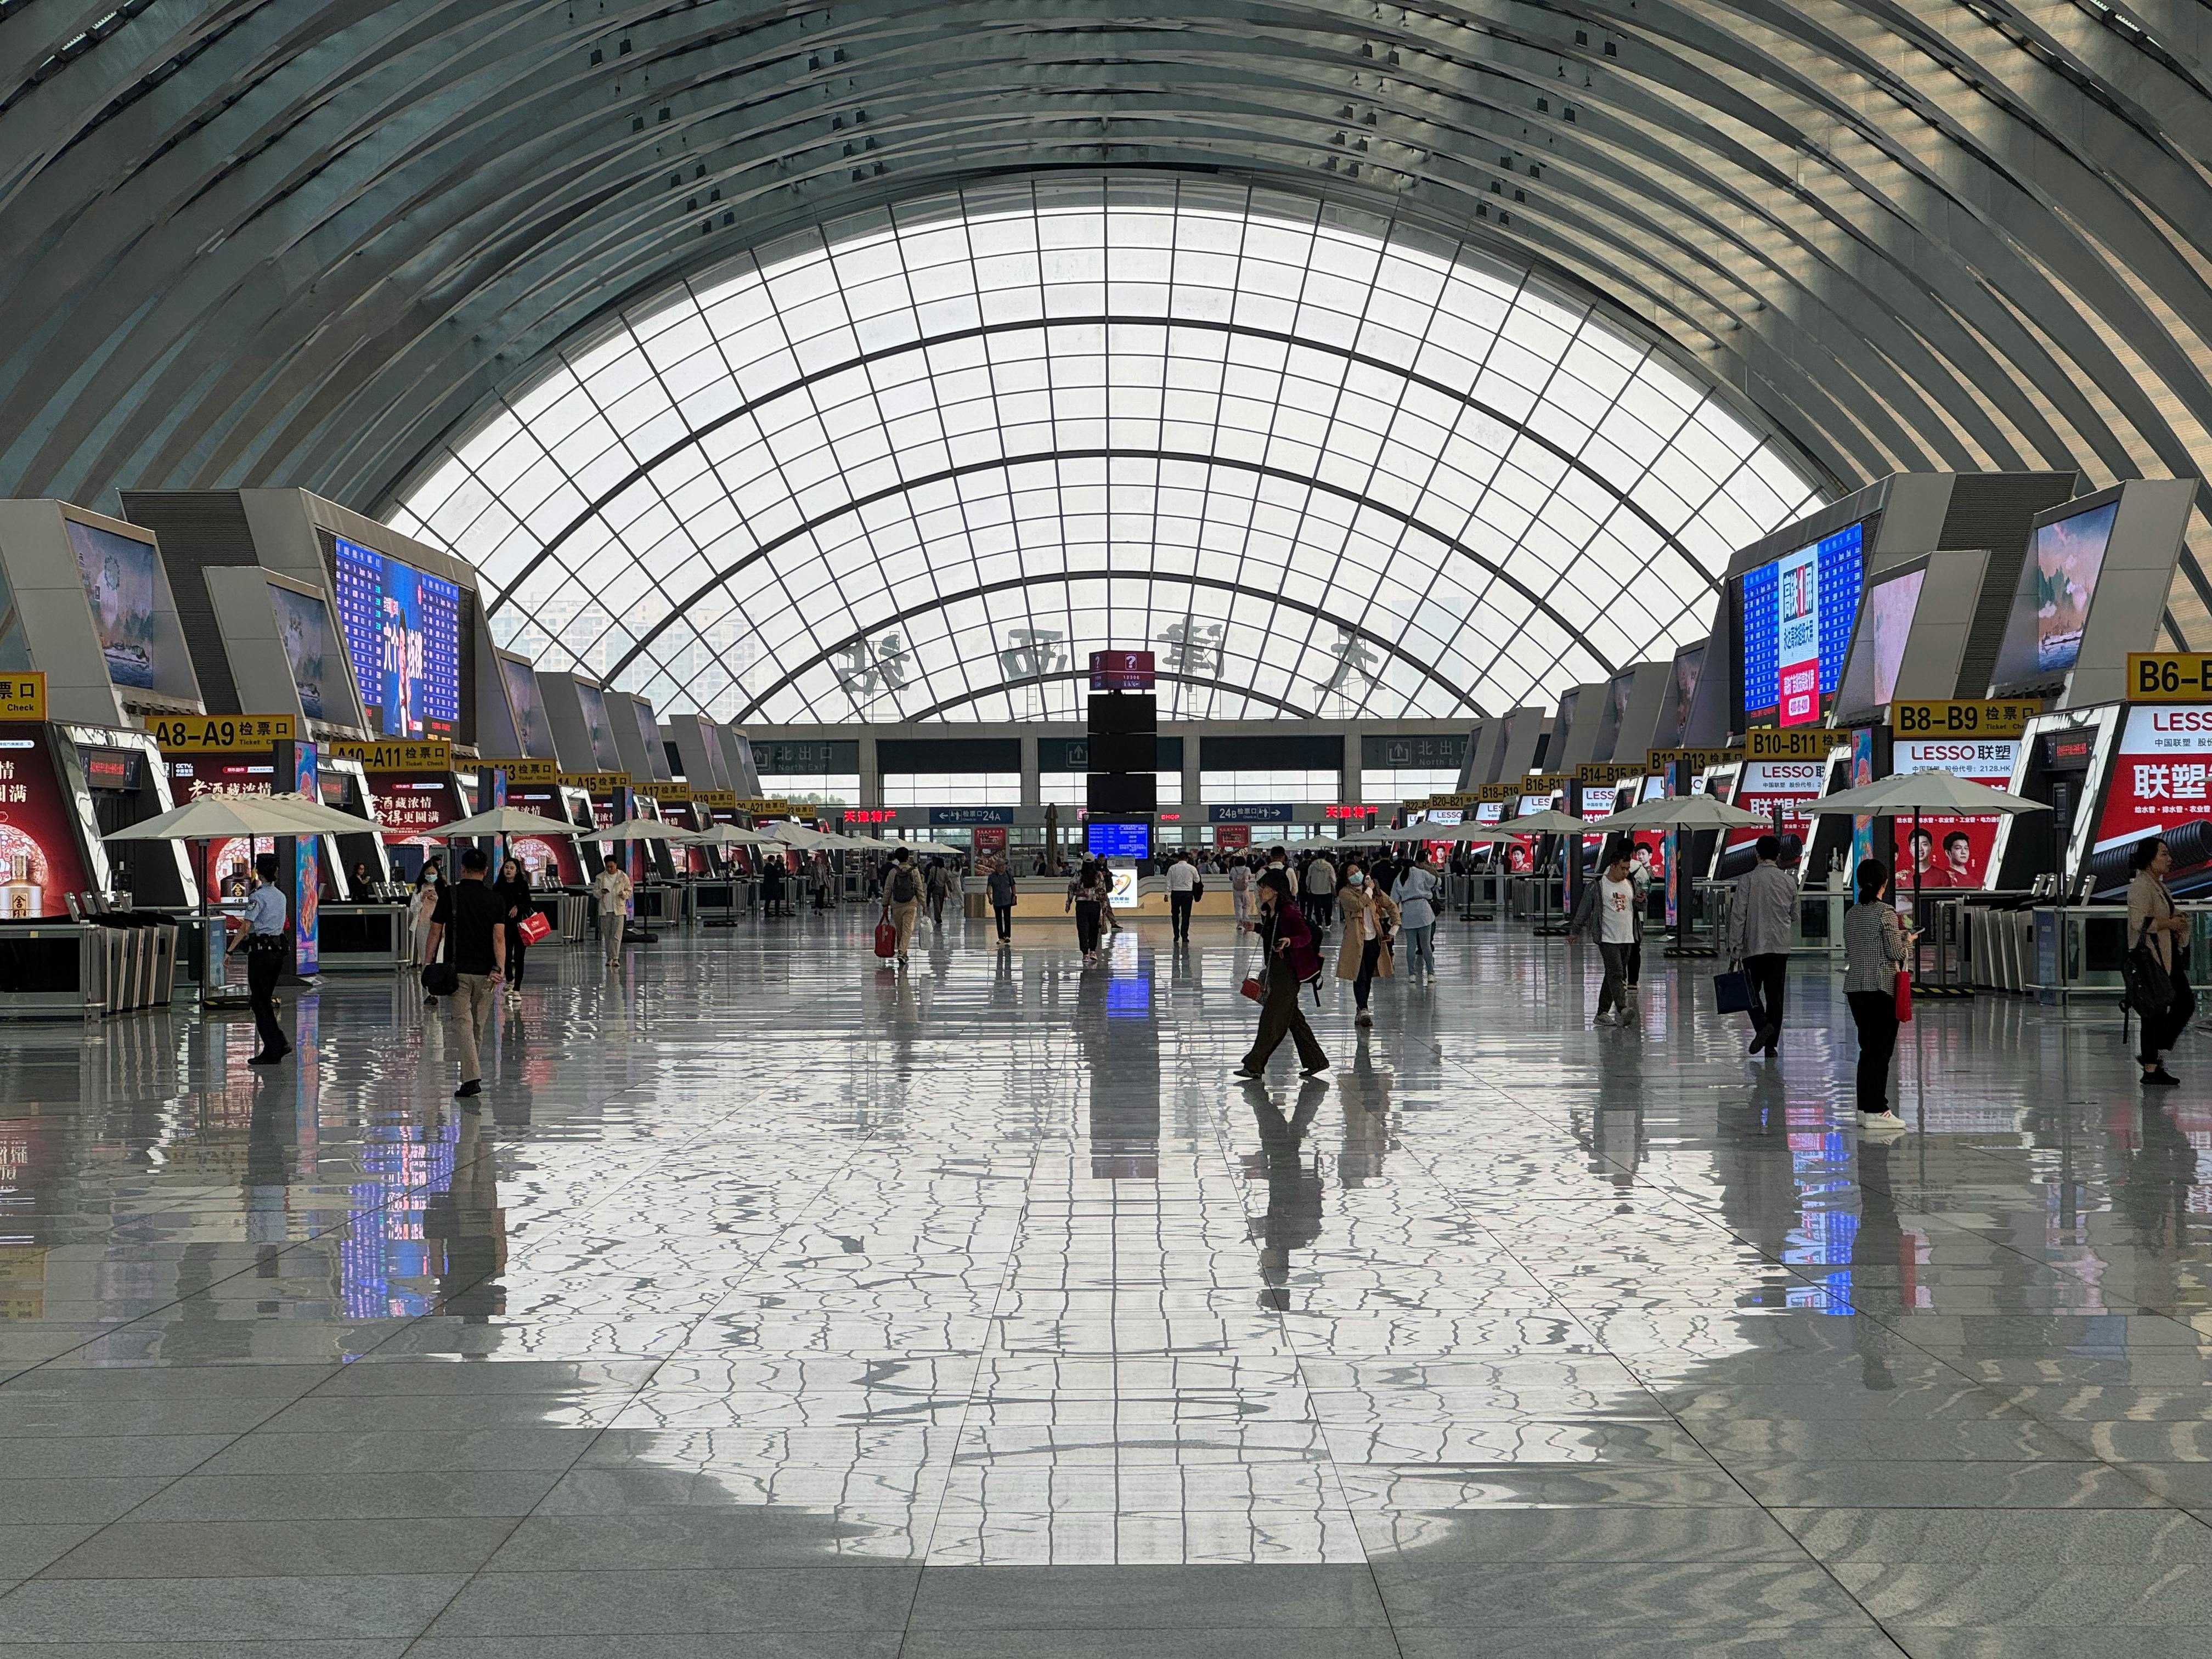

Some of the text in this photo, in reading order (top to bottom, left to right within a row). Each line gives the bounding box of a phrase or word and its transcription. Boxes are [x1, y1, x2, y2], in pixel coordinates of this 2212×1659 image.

[1900, 706, 2034, 731] B8-B9 检票口
[156, 721, 287, 746] A8-A9 检票口
[1754, 733, 1816, 754] B10-B11
[2154, 738, 2191, 747] 中国联塑
[405, 747, 444, 758] 检票口
[777, 746, 832, 760] 北出口
[1911, 745, 2011, 760] LESSO 联塑
[518, 764, 551, 774] 检票口
[1581, 767, 1627, 782] B14-B15
[1762, 766, 1814, 778] LESSO
[2133, 764, 2212, 799] 联塑
[1432, 796, 1463, 806] B20-B21
[844, 810, 896, 822] 天津特产
[983, 810, 1001, 821] 24A
[1219, 808, 1237, 819] 24B
